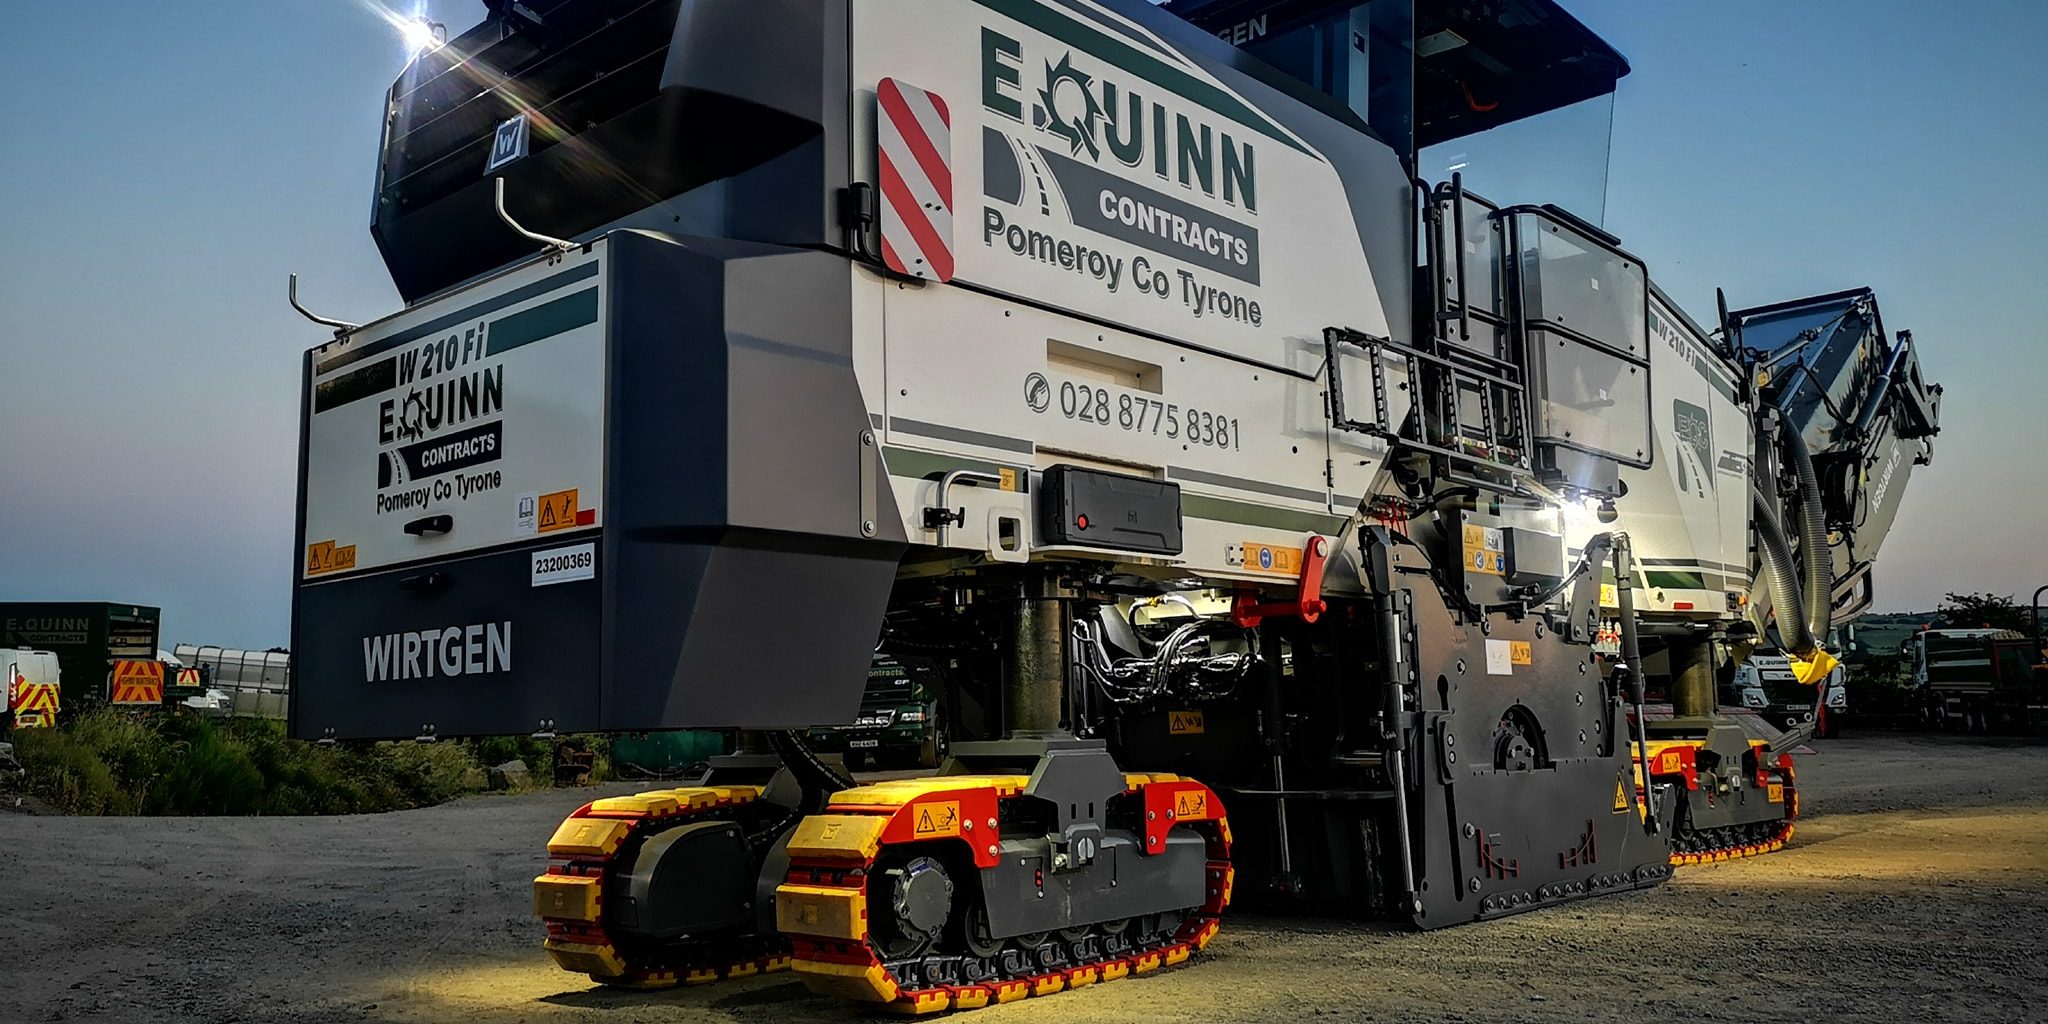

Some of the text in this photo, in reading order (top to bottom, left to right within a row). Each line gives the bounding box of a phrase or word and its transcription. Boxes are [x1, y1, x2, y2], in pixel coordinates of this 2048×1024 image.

[499, 126, 518, 155] W
[1098, 189, 1249, 266] CONTRACTS
[983, 205, 1262, 327] Pomeroy Co Tyrone
[399, 321, 486, 387] W 210 Fi
[1658, 319, 1695, 367] W 210 Fi
[1060, 381, 1240, 452] 028 8775 8381
[421, 433, 495, 468] CONTRACTS
[377, 469, 502, 515] Pomeroy Co Tyrone
[535, 551, 592, 575] 23200369
[6, 617, 89, 631] E.QUINN
[30, 634, 85, 642] CONTRACTS
[363, 621, 512, 683] WIRTGEN
